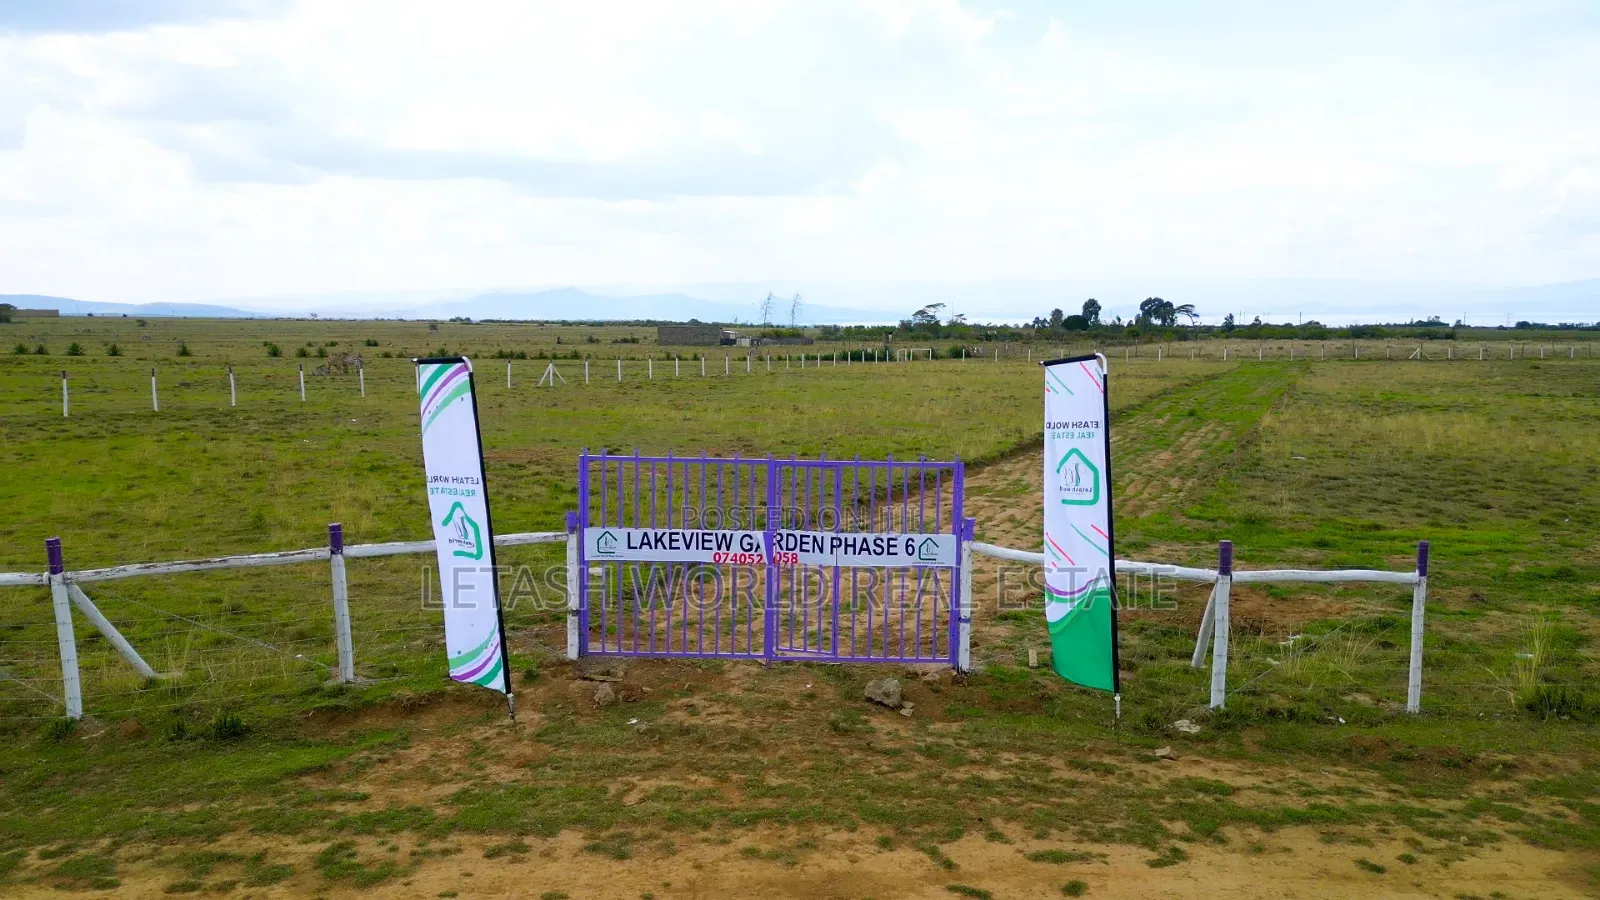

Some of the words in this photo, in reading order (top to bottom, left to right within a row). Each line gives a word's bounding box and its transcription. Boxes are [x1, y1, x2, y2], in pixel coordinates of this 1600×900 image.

[627, 531, 734, 552] LAKEVIEW
[830, 536, 898, 556] PHASE
[904, 537, 916, 557] 6
[712, 551, 799, 565] 074052058
